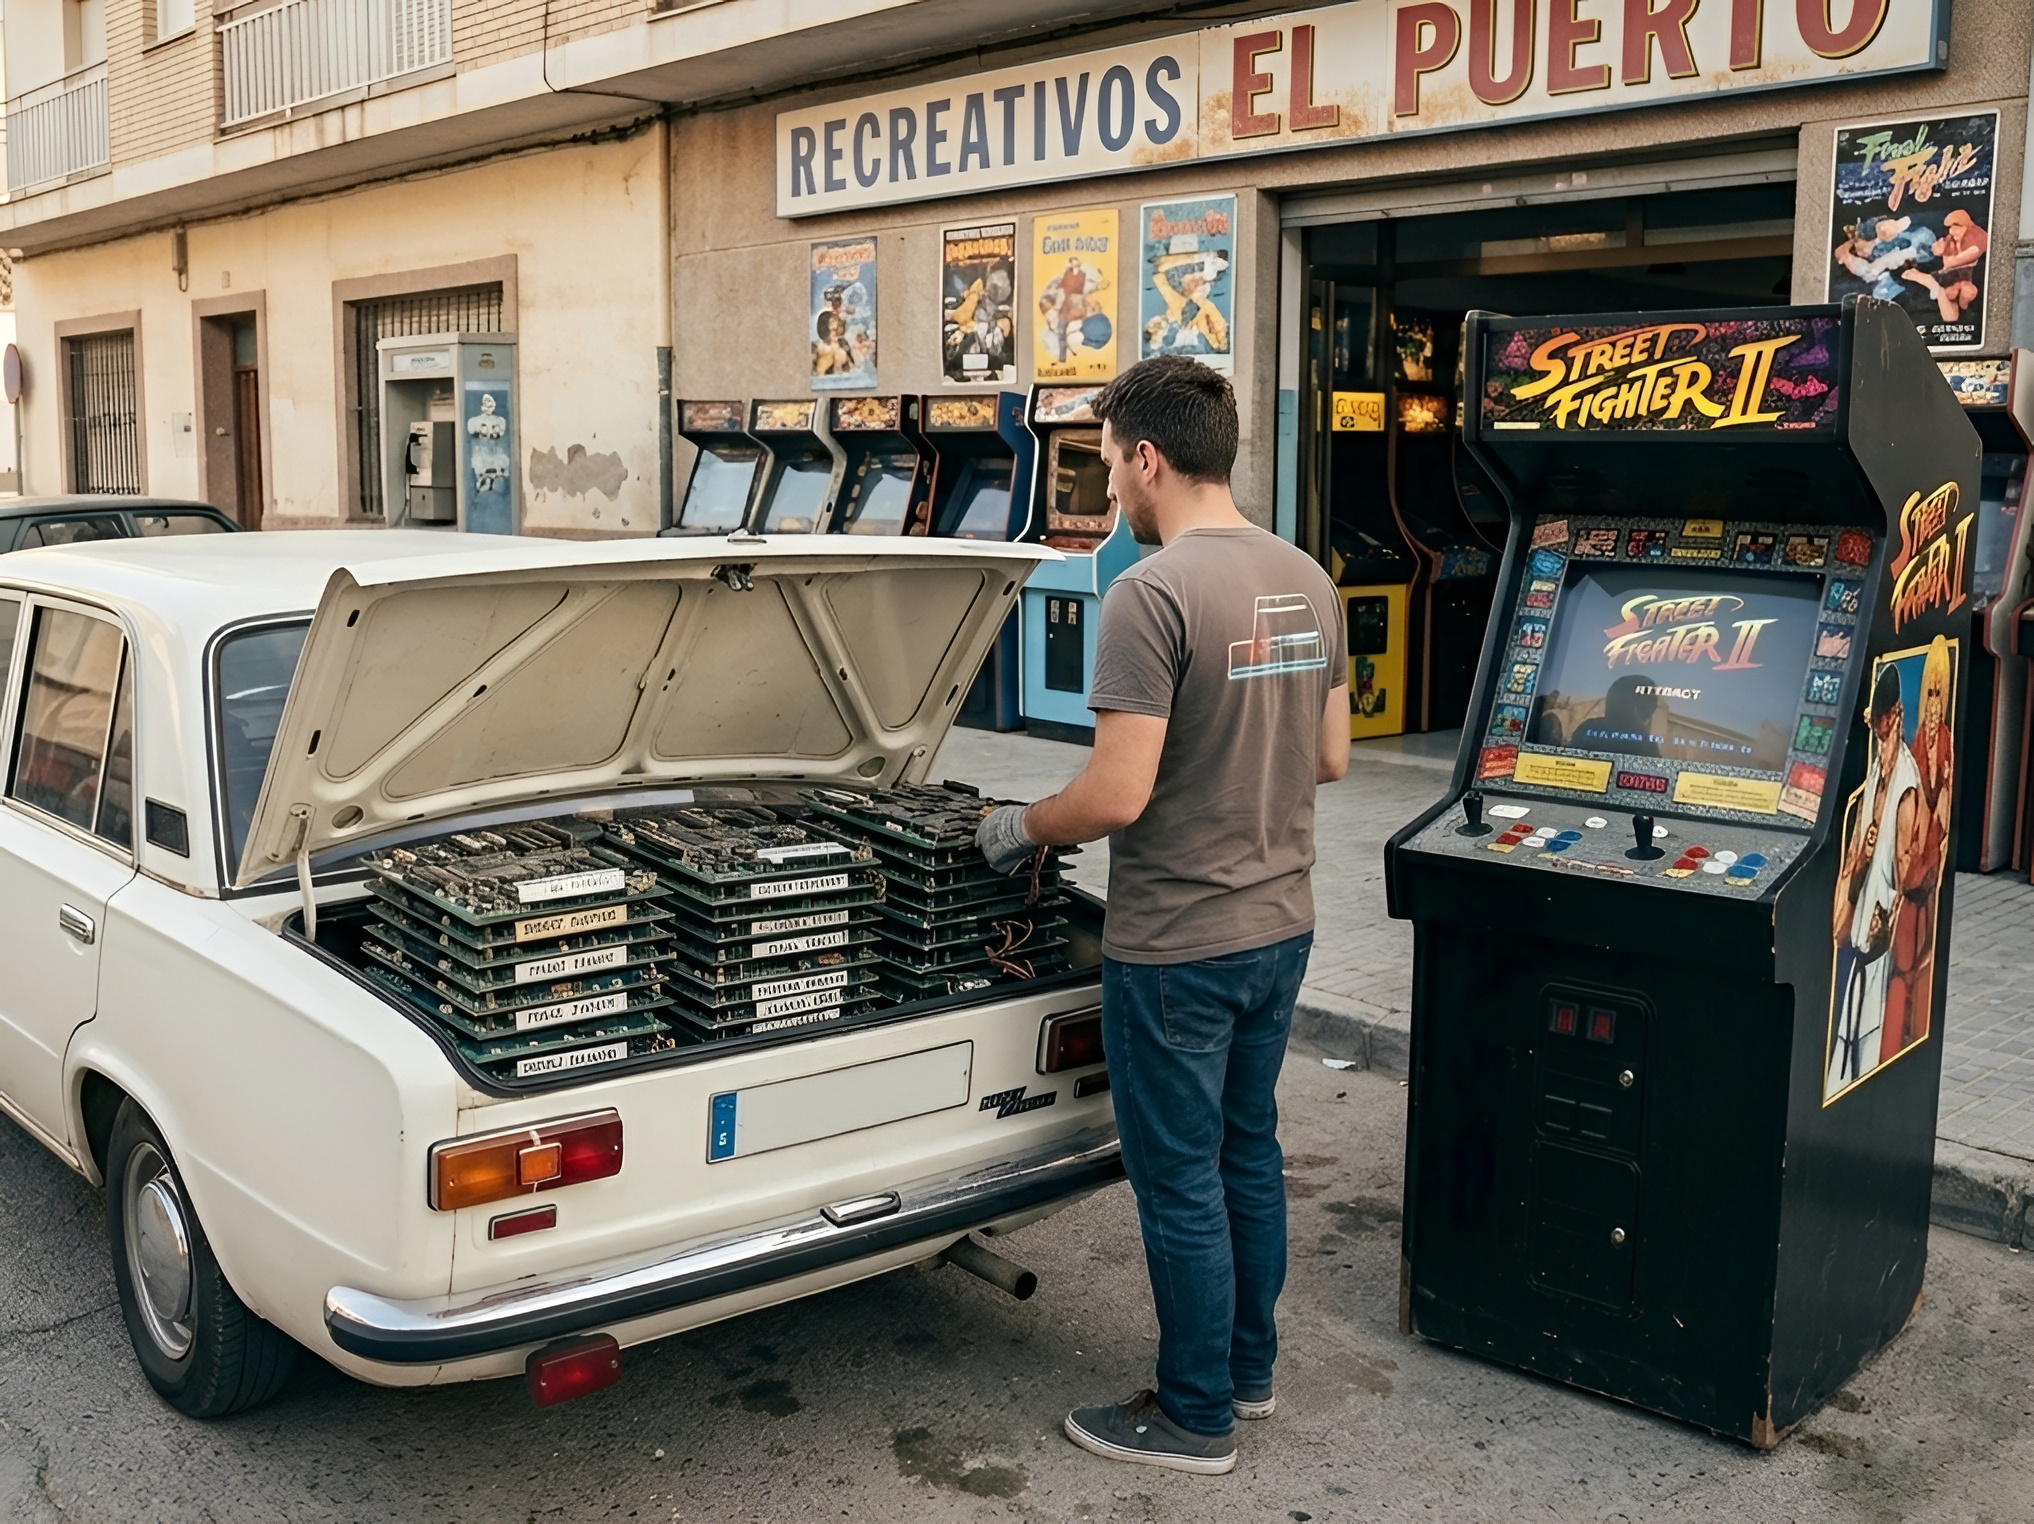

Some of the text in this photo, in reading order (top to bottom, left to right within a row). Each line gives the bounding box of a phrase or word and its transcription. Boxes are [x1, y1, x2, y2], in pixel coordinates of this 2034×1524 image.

[790, 0, 1892, 197] RECREATIVOS EL PUERTO
[1510, 323, 1706, 400] STREET
[1543, 356, 1726, 429] FIGHTER
